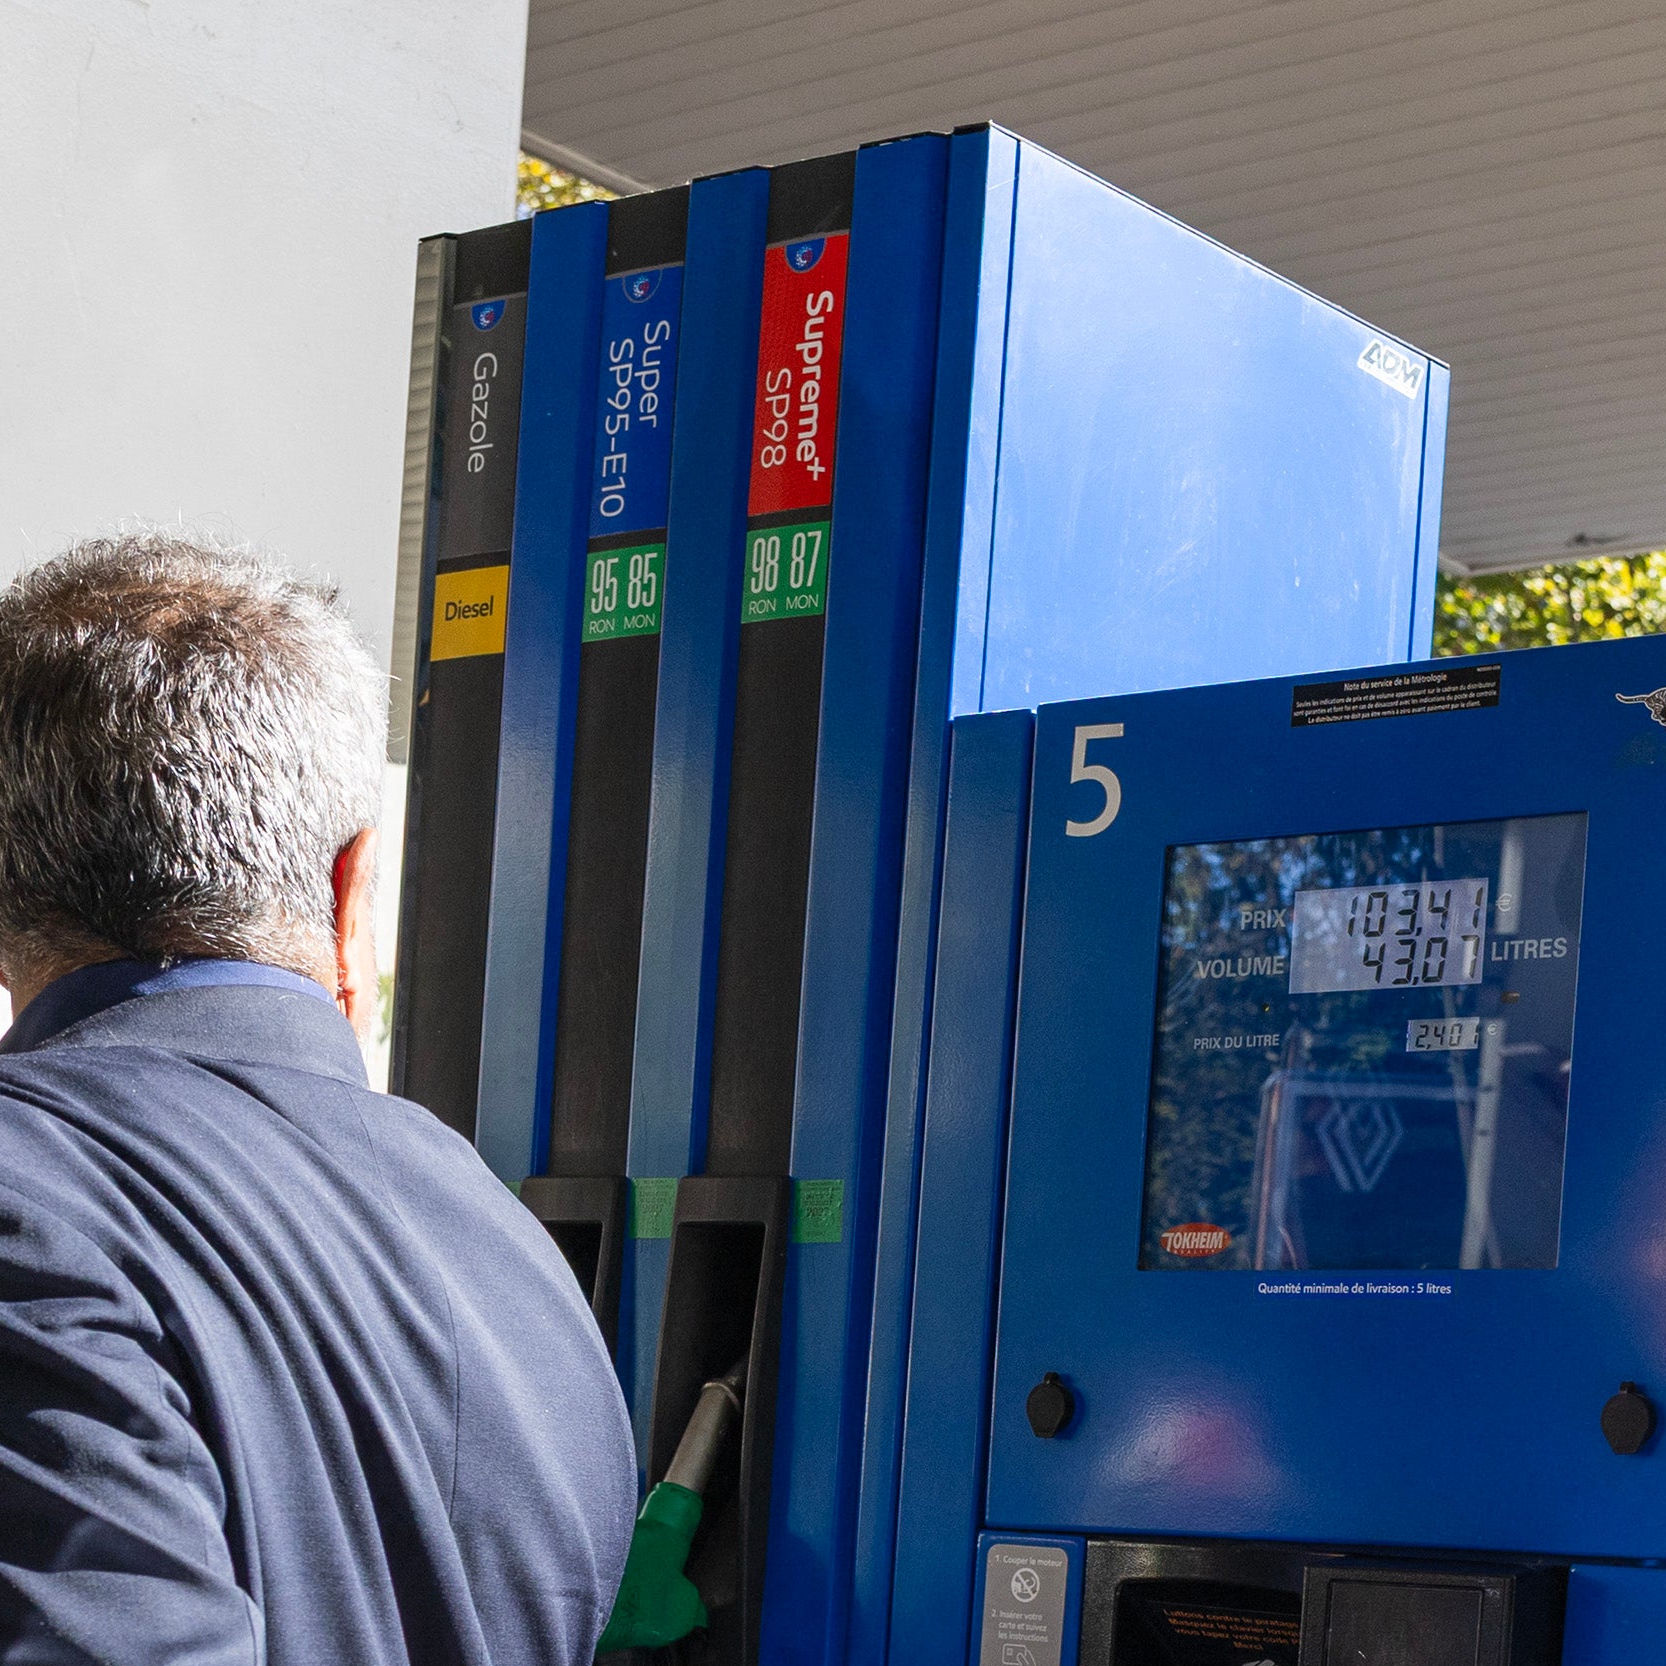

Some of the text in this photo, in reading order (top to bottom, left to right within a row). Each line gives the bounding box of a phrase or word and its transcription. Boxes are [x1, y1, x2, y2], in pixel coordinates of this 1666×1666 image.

[634, 319, 670, 428] Super
[796, 290, 834, 481] Supreme+
[467, 352, 498, 473] Gazole
[761, 368, 792, 469] SP98
[599, 338, 634, 518] SP95-E10
[751, 530, 822, 593] 98 87
[590, 553, 657, 614] 95 85
[444, 596, 494, 623] Diesel
[748, 593, 819, 614] RON MON
[589, 614, 655, 634] RON MON
[1344, 672, 1448, 692] Note du service de la Métrologie
[1065, 723, 1125, 837] 5
[1240, 887, 1512, 938] PRIX 103,41 €
[1197, 934, 1568, 986] VOLUME 43,07 LITRES
[1193, 1023, 1498, 1050] PRIX DU LITRE 2,401 €
[1161, 1231, 1225, 1254] TOKHEIM
[1258, 1282, 1302, 1295] Quantité
[1303, 1283, 1349, 1294] minimale
[1351, 1283, 1365, 1294] de
[1366, 1283, 1409, 1294] livraison
[1416, 1283, 1424, 1294] 5
[1425, 1282, 1452, 1294] litres
[1003, 1555, 1029, 1566] Couper
[1029, 1557, 1037, 1565] le
[1037, 1559, 1063, 1567] moteur
[999, 1610, 1024, 1619] Insérer
[1024, 1613, 1043, 1621] votre
[1017, 1623, 1025, 1631] et
[1025, 1624, 1047, 1632] suivez
[998, 1631, 1049, 1642] les instructions
